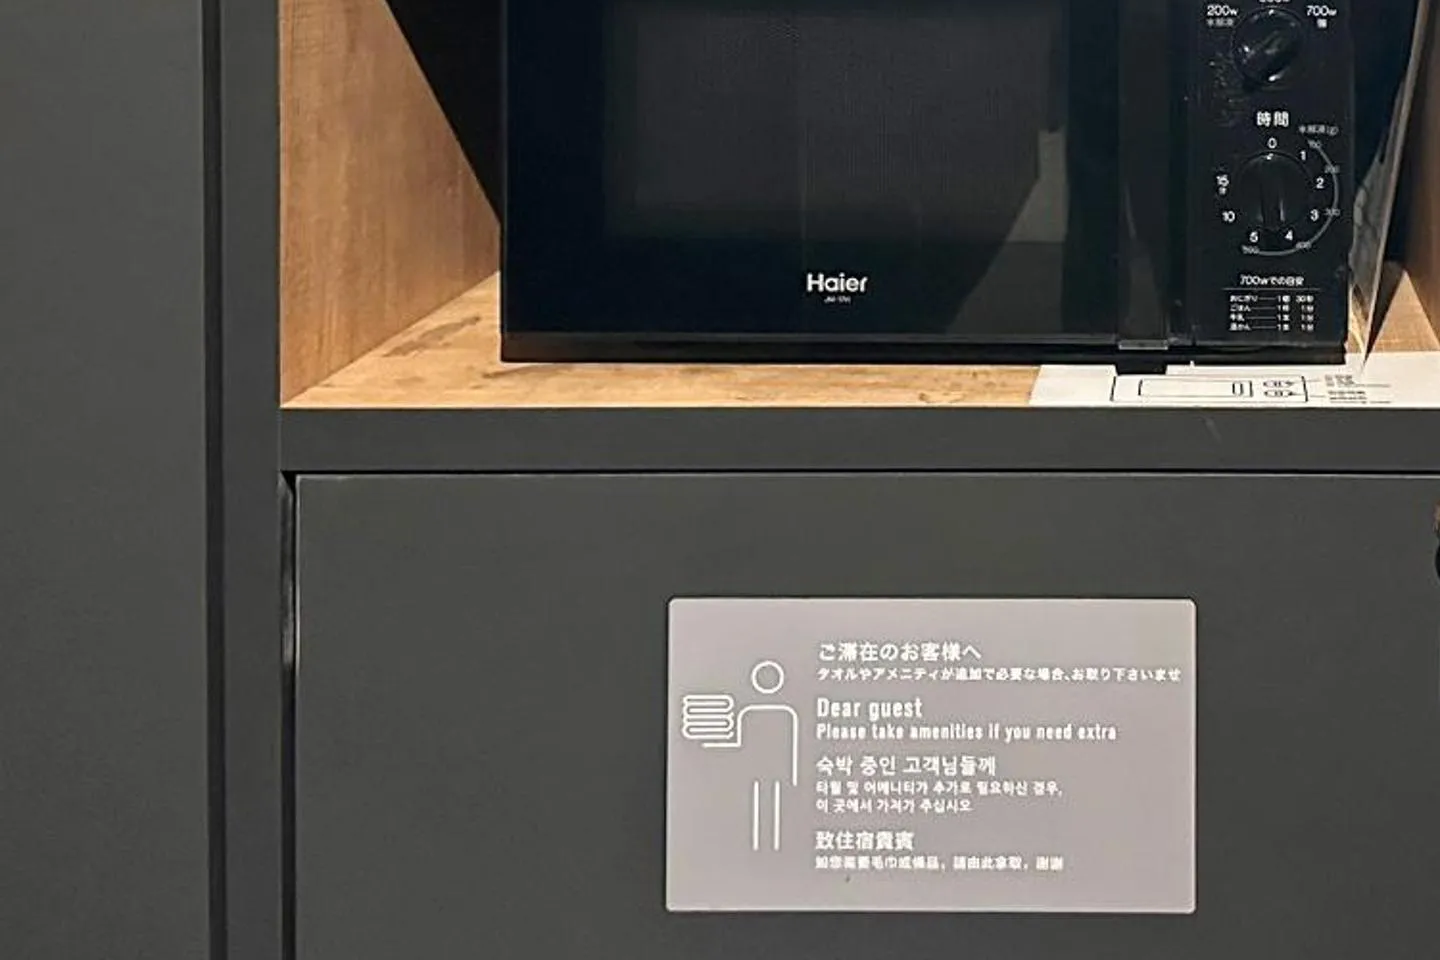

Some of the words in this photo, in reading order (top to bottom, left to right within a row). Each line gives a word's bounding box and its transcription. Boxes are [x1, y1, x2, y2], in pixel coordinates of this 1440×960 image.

[1256, 111, 1290, 127] 時間
[1267, 137, 1277, 149] 0
[1300, 150, 1307, 161] 1
[1316, 177, 1325, 189] 2
[1222, 211, 1236, 223] 10
[1310, 209, 1319, 221] 3
[1250, 231, 1259, 243] 5
[1285, 230, 1294, 240] 4
[806, 272, 868, 292] Haier
[818, 641, 982, 662] ご滞在のお客様へ
[816, 697, 861, 717] Dear
[868, 697, 923, 722] guest
[816, 723, 867, 739] Please
[871, 723, 904, 739] take
[909, 723, 984, 740] amenities
[988, 723, 1001, 739] if
[1004, 725, 1031, 743] you
[1036, 723, 1072, 740] need
[1078, 723, 1117, 740] extra
[815, 755, 853, 776] 숙박
[860, 755, 897, 776] 중인
[902, 755, 996, 776] 고객님들께
[815, 780, 842, 795] 타월
[846, 780, 859, 796] 및
[863, 780, 928, 795] 어메니티가
[933, 780, 972, 796] 추가로
[976, 780, 1029, 796] 필요하신
[1033, 780, 1063, 797] 경우,
[815, 798, 829, 813] 이
[832, 798, 873, 813] 곳에서
[876, 798, 915, 813] 가져가
[919, 798, 974, 813] 주십시오
[815, 830, 915, 851] 致住宿貴賓
